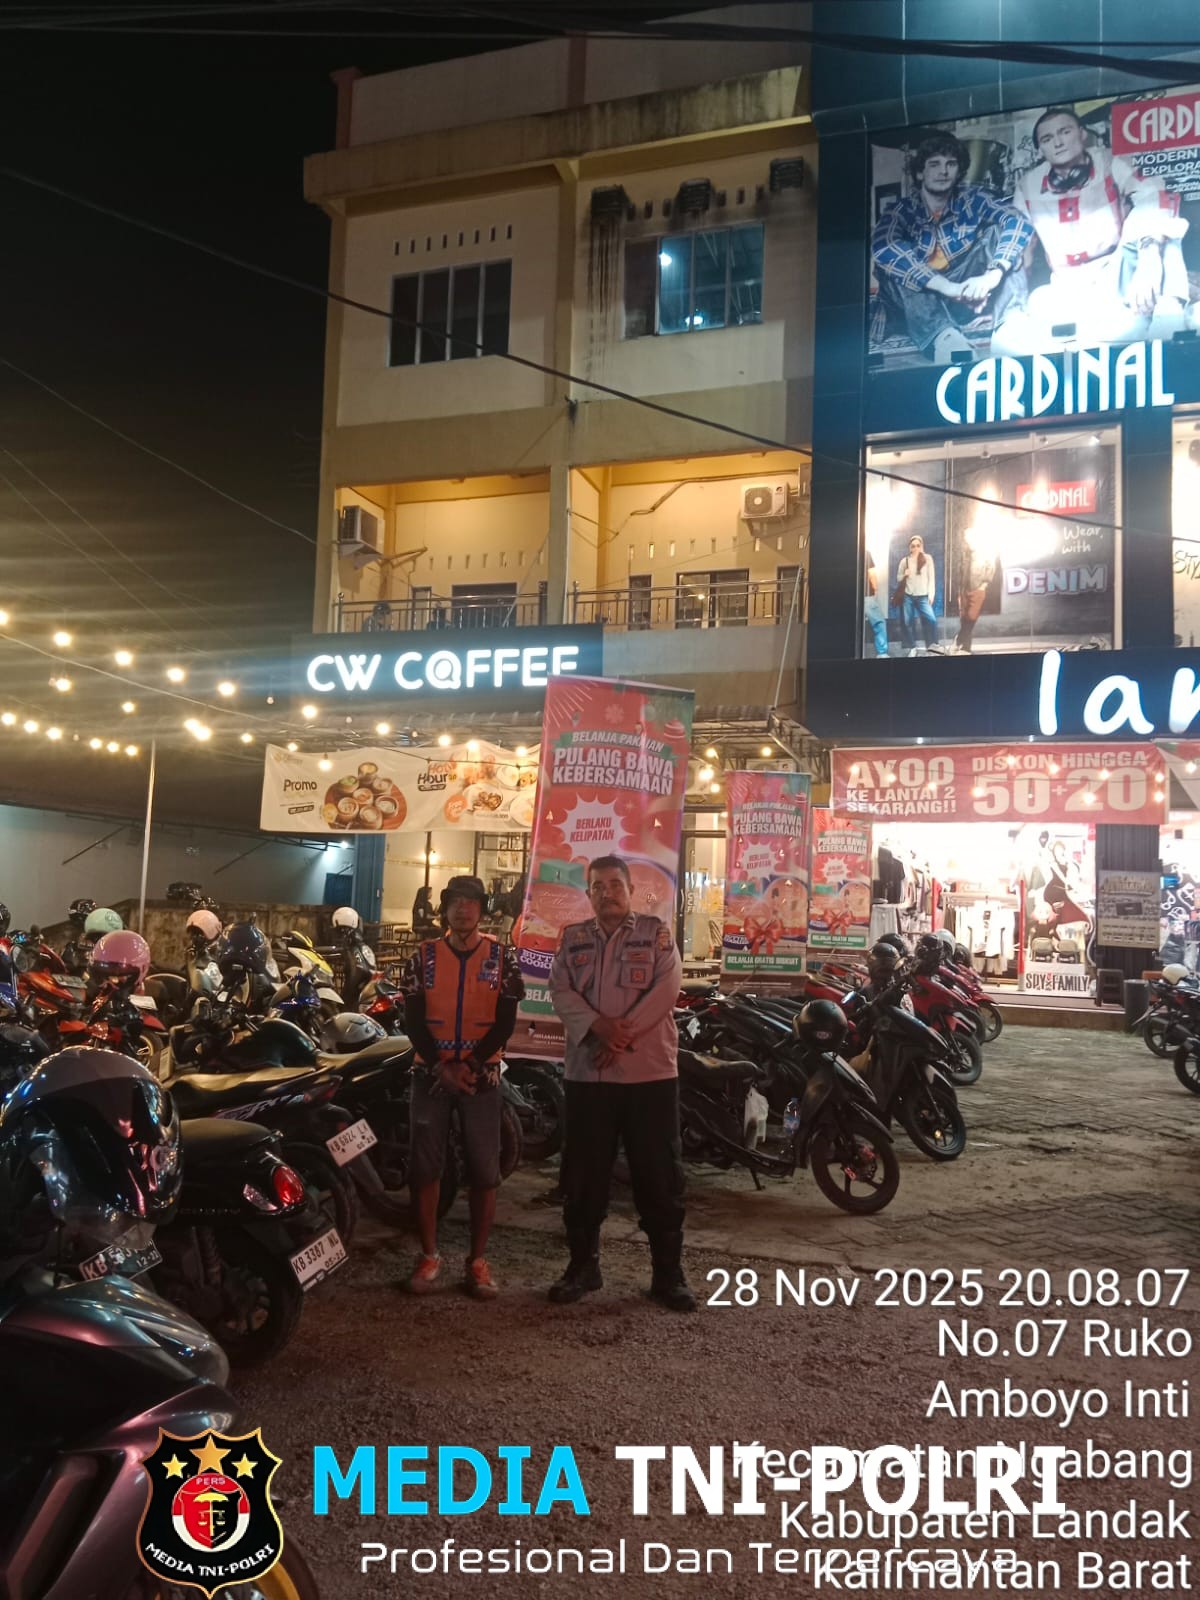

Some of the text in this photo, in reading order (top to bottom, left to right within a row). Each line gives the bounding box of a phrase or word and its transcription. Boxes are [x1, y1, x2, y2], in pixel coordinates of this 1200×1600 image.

[1132, 148, 1198, 166] MODERN
[936, 339, 1175, 424] CARDINAL
[1021, 487, 1090, 509] CDINAL
[1061, 541, 1091, 554] with
[1006, 565, 1106, 594] DENIM
[307, 654, 381, 691] CW
[572, 730, 665, 753] BELANJA PAKAIAN
[554, 748, 674, 780] PULANG BAWA
[972, 751, 1148, 772] DISKON HINGGA
[417, 773, 448, 785] Hour
[552, 766, 673, 796] KEBERSAMAAN
[846, 756, 954, 789] AYOO
[283, 778, 318, 792] Promo
[846, 786, 955, 802] KE LANTAI 2
[846, 800, 957, 816] SEKARANG!!
[576, 817, 612, 829] BERLAKU
[733, 812, 802, 826] PULANG BAWA
[570, 830, 615, 842] KELIPATAN
[733, 822, 802, 837] KEBERSAMAAN
[293, 1256, 306, 1274] KB
